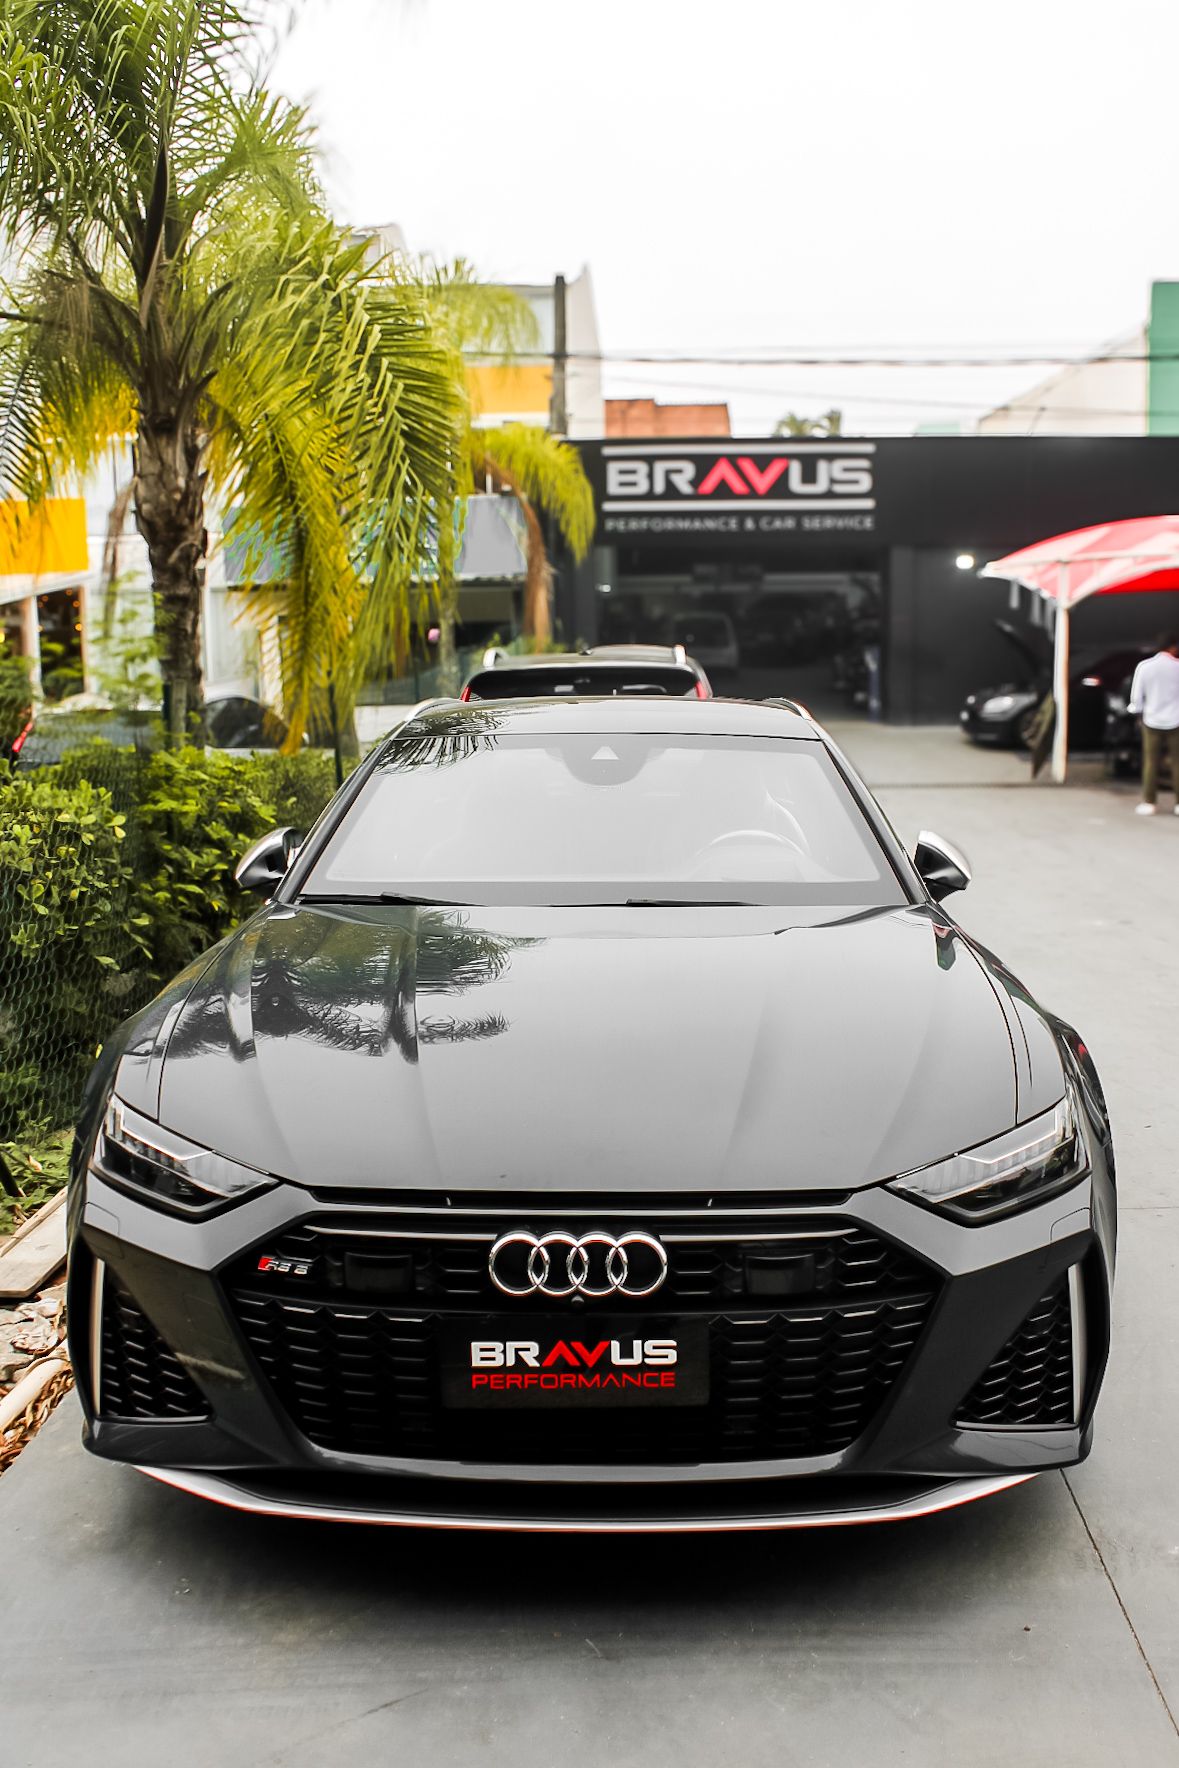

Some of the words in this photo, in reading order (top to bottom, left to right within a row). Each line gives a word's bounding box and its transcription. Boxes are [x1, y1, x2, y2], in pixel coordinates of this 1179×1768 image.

[606, 457, 873, 495] BRAVUS
[604, 516, 739, 532] PERFORMANCE
[744, 516, 756, 531] &
[759, 515, 797, 531] CAR
[801, 515, 875, 531] SERVICE
[471, 1340, 677, 1367] BRAVUS
[471, 1372, 675, 1389] PERFORMANCE
